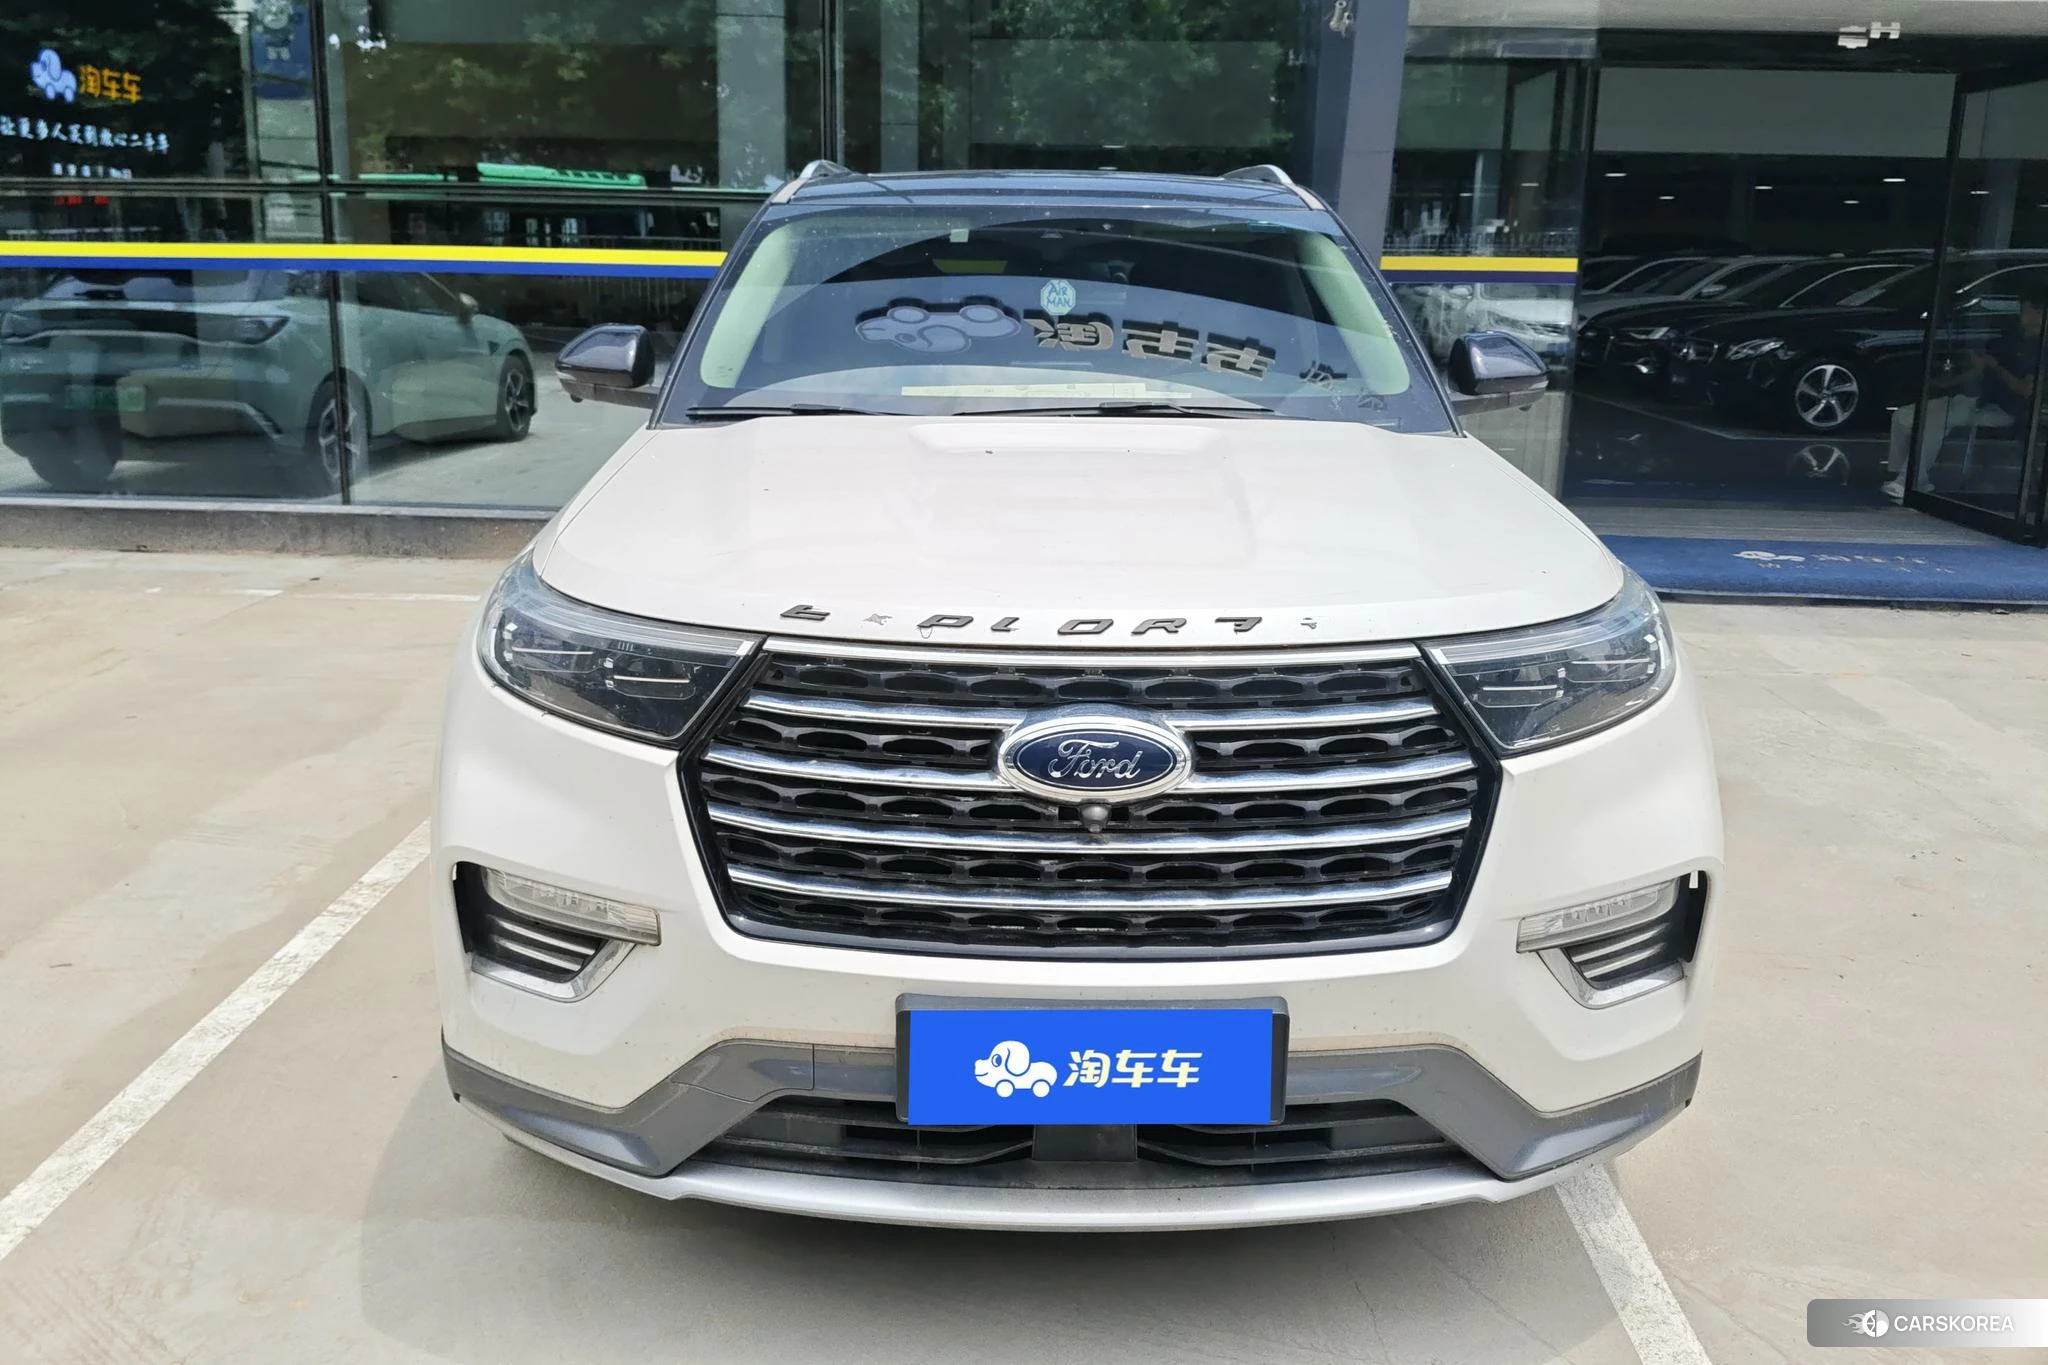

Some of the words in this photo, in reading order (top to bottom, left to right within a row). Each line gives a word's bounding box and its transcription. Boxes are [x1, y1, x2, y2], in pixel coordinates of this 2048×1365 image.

[79, 64, 141, 104] 淘车车
[780, 604, 1318, 635] EPLOR
[1047, 739, 1143, 779] Ford
